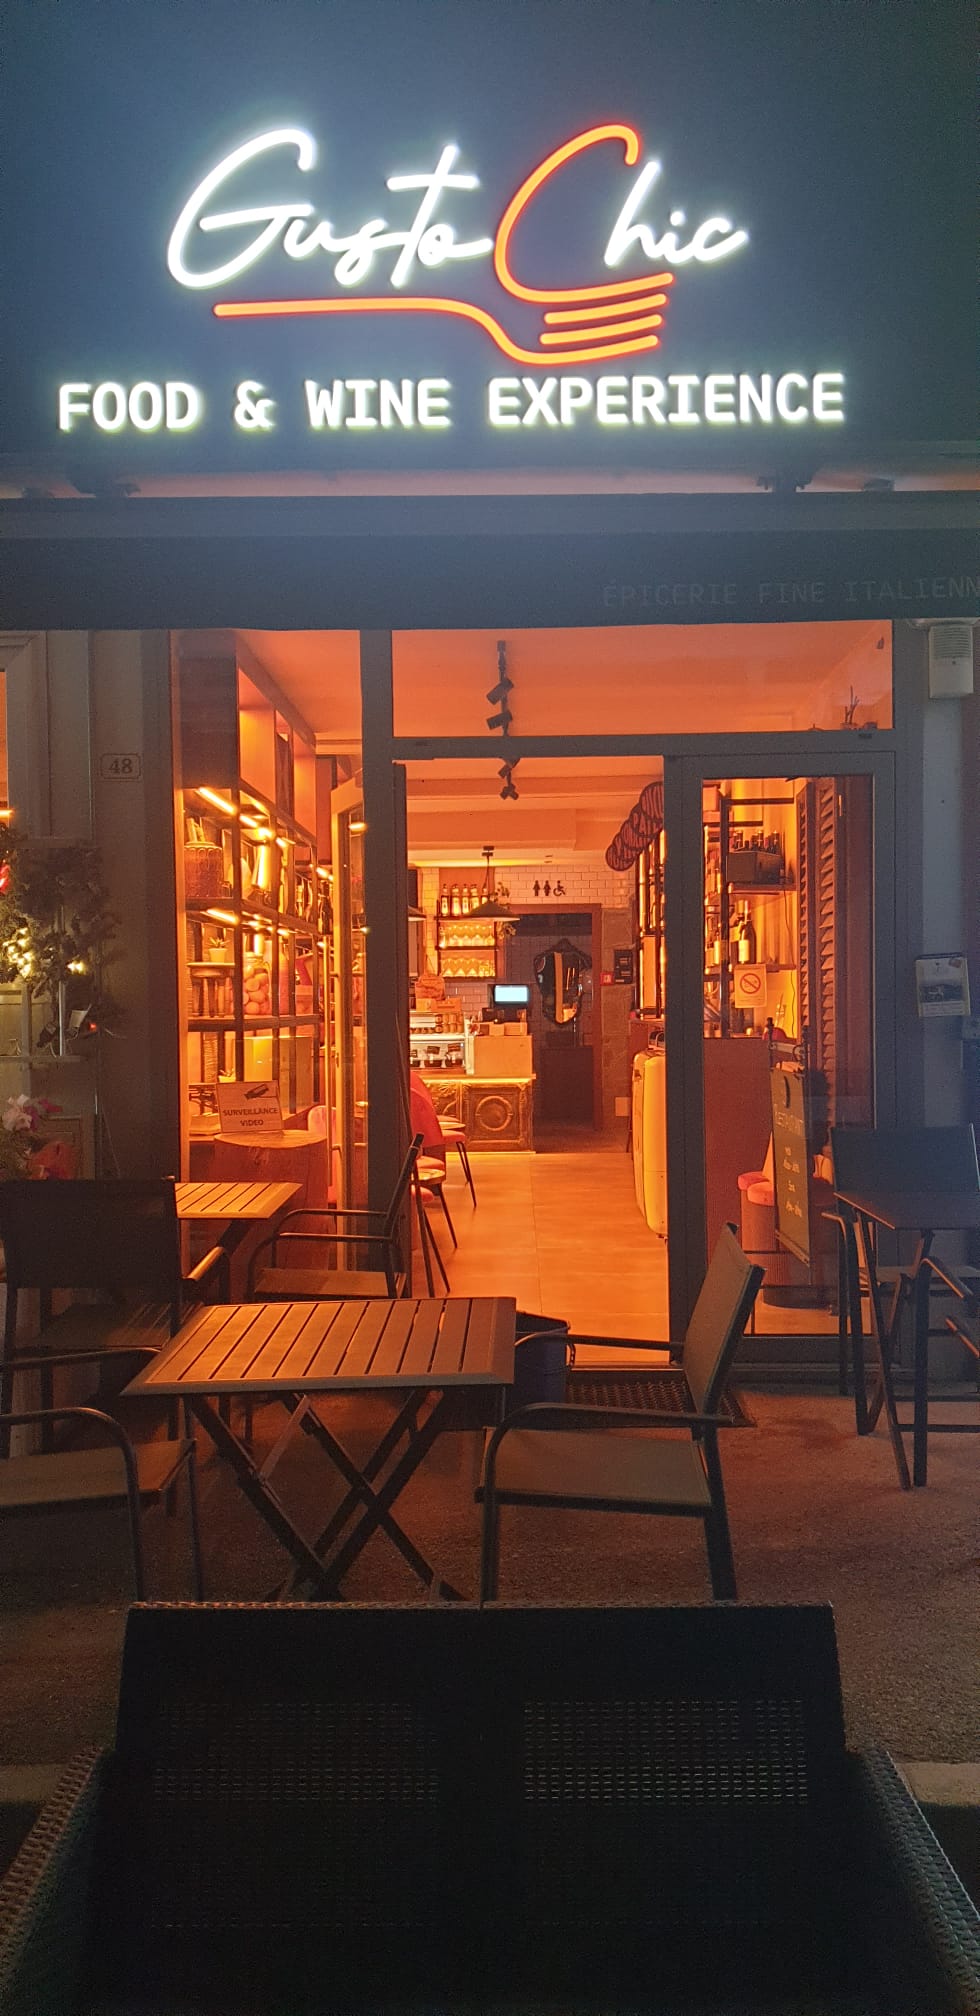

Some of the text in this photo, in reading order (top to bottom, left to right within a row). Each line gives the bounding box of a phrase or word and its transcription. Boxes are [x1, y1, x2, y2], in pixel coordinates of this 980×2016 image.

[167, 123, 749, 302] Gusto Chic
[59, 372, 845, 432] FOOD & WINE EXPERIENCE
[603, 578, 738, 608] ÉPICERIE
[758, 581, 827, 605] FINE
[108, 757, 134, 775] 48
[223, 1107, 278, 1116] SURVEILLANCE
[240, 1119, 264, 1127] VIDEO
